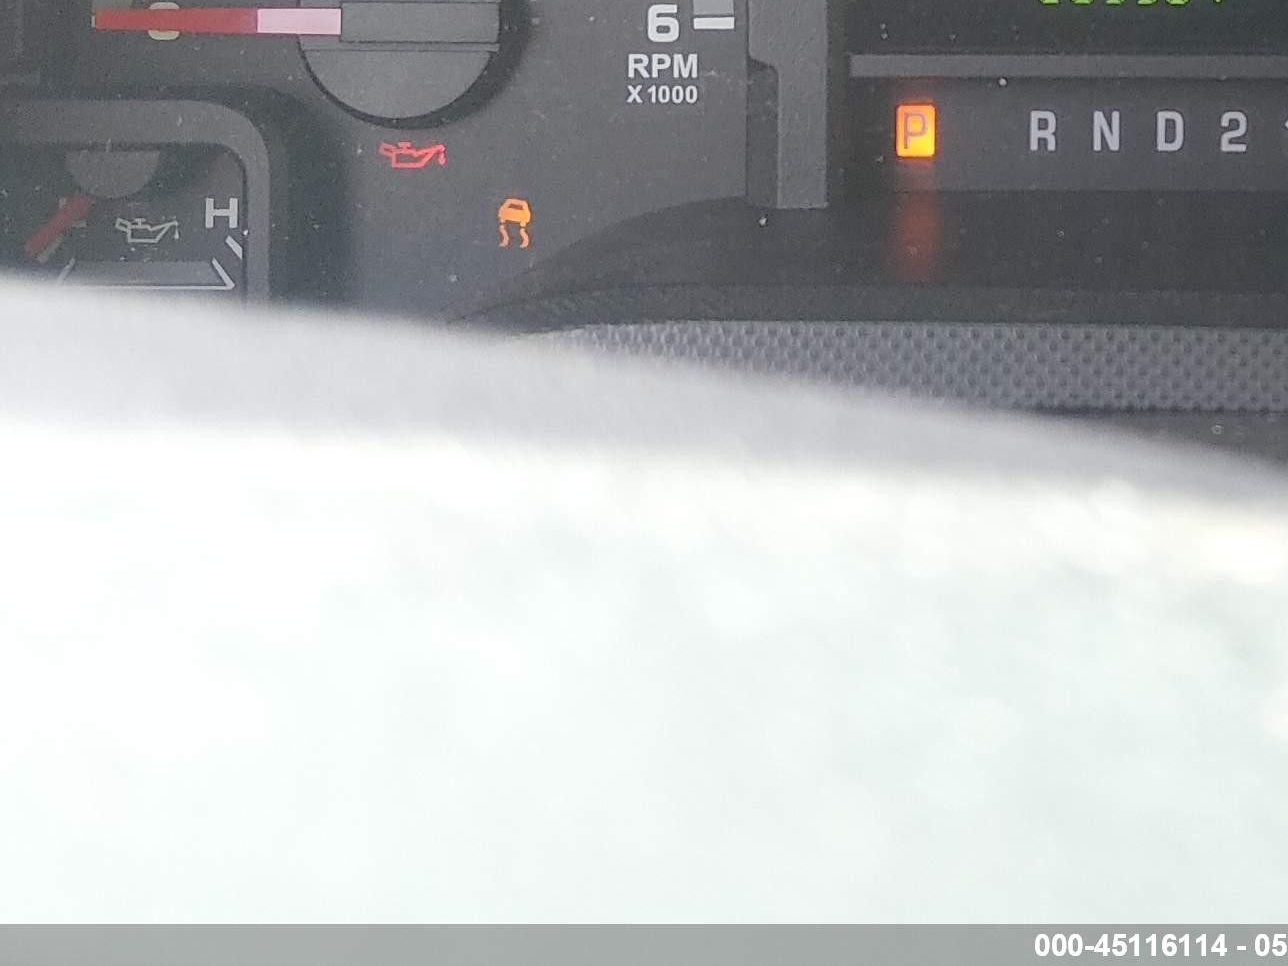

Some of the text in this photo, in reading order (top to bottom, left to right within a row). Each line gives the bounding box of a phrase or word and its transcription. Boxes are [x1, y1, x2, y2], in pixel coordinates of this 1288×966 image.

[646, 4, 679, 43] 6
[627, 54, 699, 79] RPM
[627, 85, 698, 104] X 1000
[903, 113, 927, 149] P
[1029, 111, 1057, 152] R
[1093, 111, 1121, 152] N
[1157, 111, 1185, 152] D
[1220, 111, 1247, 152] 2
[205, 197, 239, 229] H
